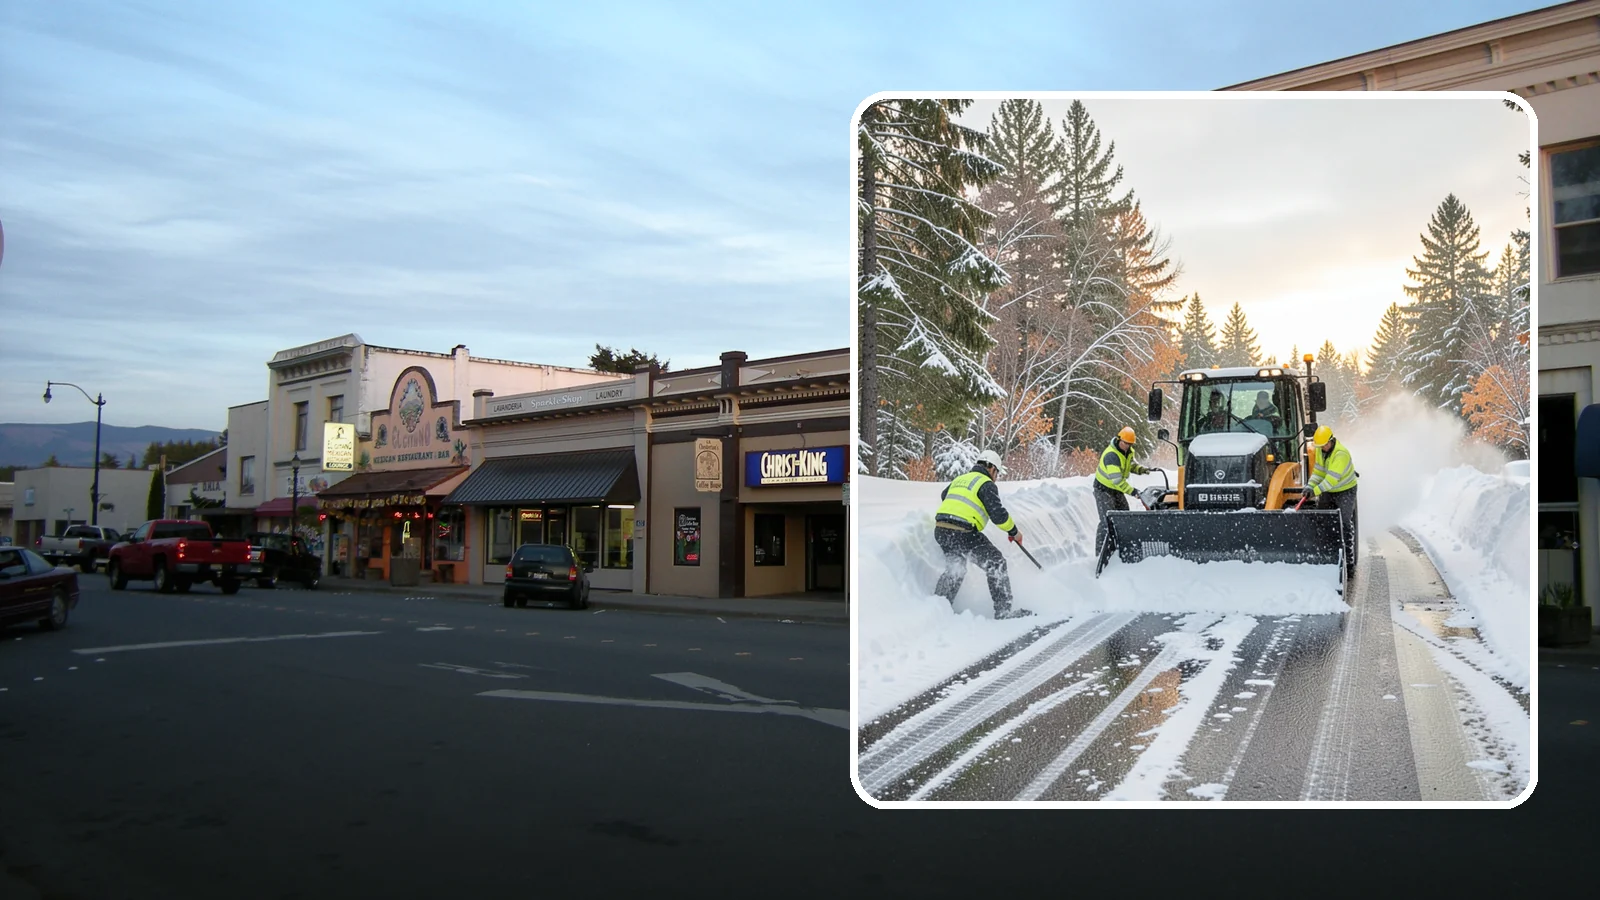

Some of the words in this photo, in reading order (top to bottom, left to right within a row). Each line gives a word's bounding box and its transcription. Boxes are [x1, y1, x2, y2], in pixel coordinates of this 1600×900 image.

[562, 393, 583, 404] Shop
[595, 389, 624, 400] LAUNDRY
[493, 402, 523, 413] LAVANDERIA
[397, 451, 433, 462] RESTAURANT
[437, 450, 450, 458] BAR
[760, 452, 797, 478] CHRIST
[798, 450, 828, 476] KING
